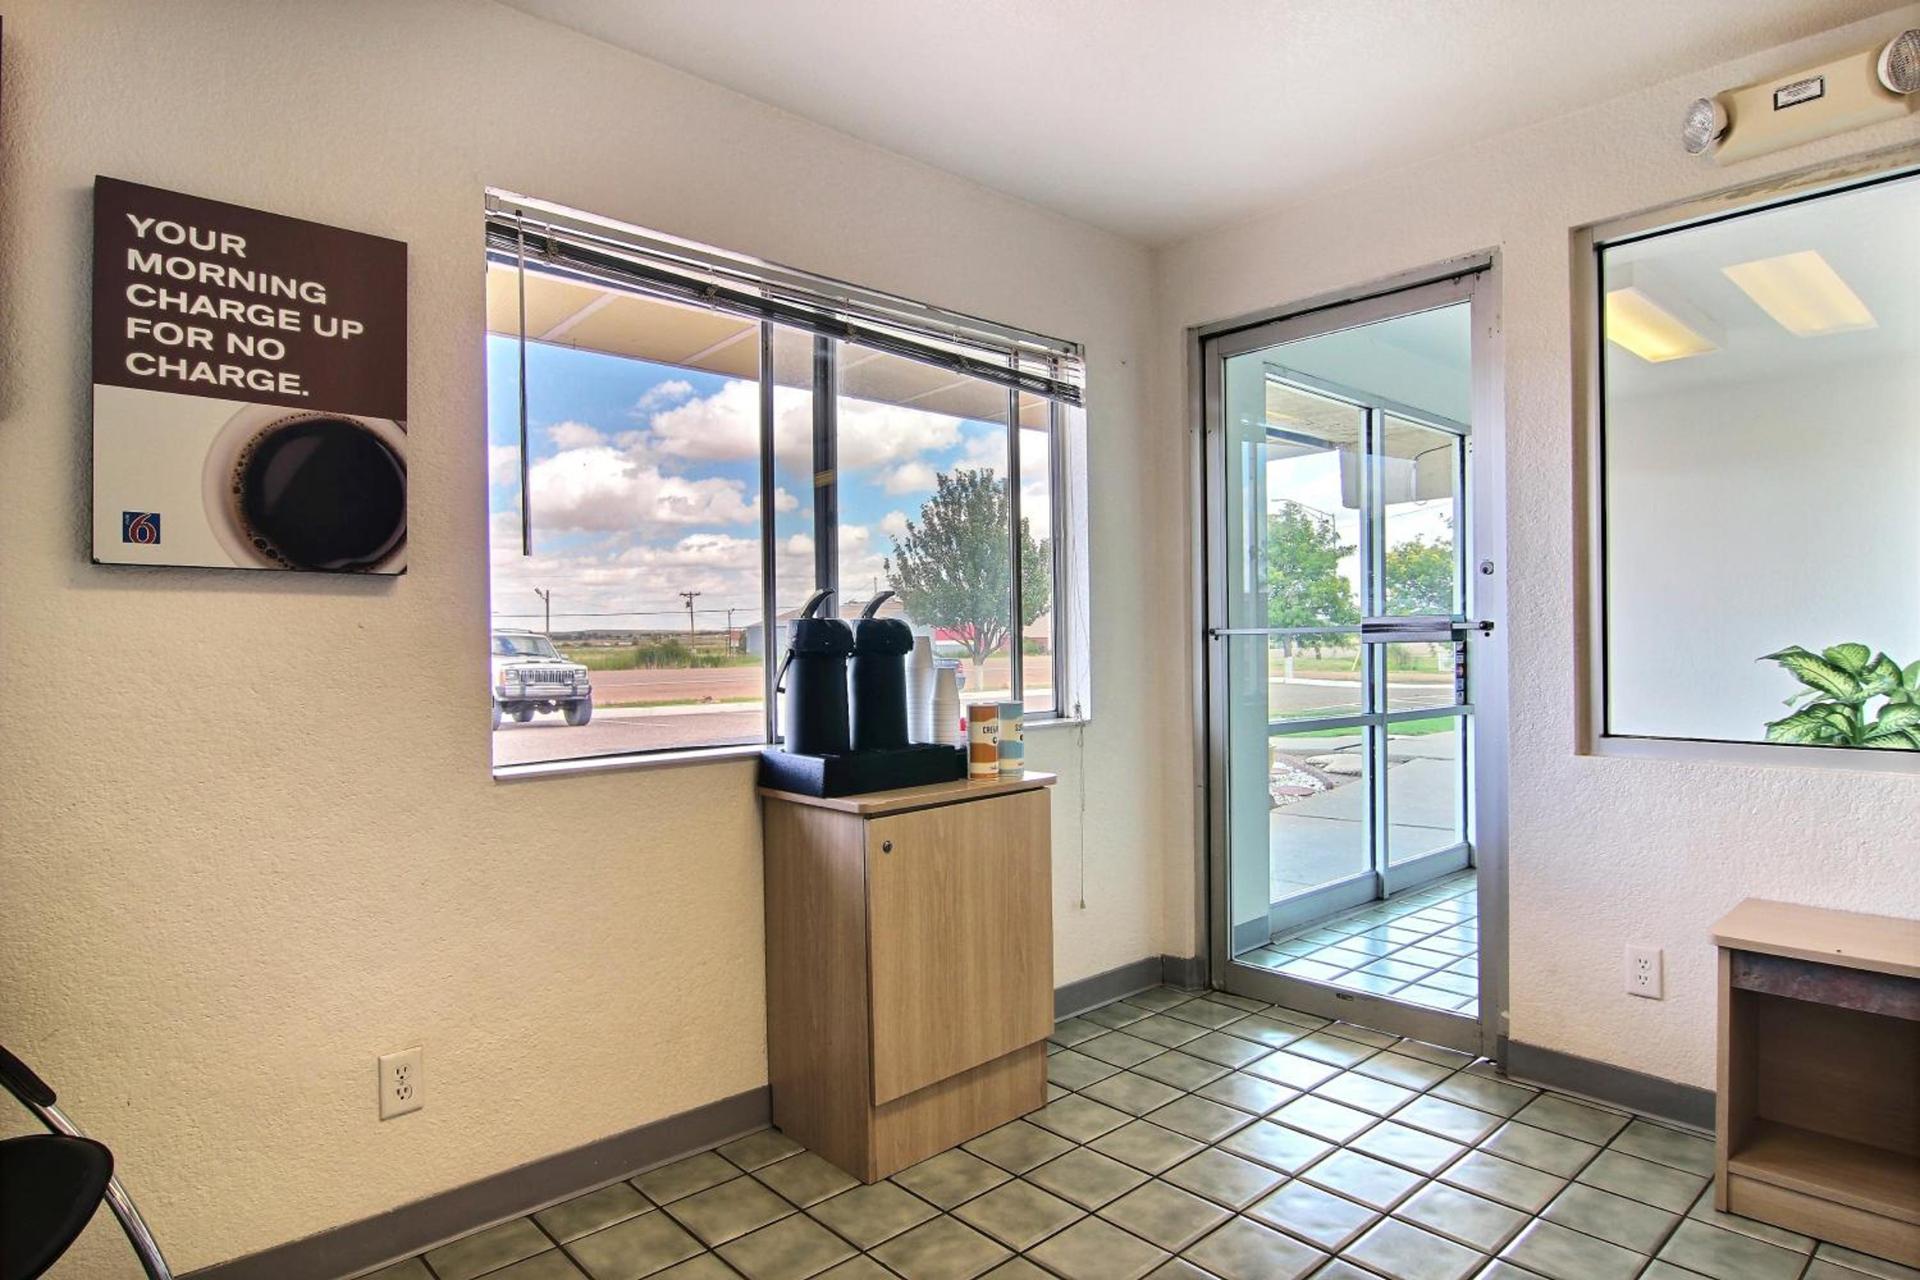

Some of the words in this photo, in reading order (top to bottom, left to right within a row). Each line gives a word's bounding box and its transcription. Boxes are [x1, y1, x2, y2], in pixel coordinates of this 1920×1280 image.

[126, 213, 247, 258] YOUR
[127, 248, 327, 305] MORNING
[126, 283, 302, 332] CHARGE
[313, 315, 364, 340] UP
[127, 317, 214, 351] FOR
[228, 332, 286, 361] NO
[126, 352, 309, 397] CHARGE.
[129, 513, 156, 544] 6
